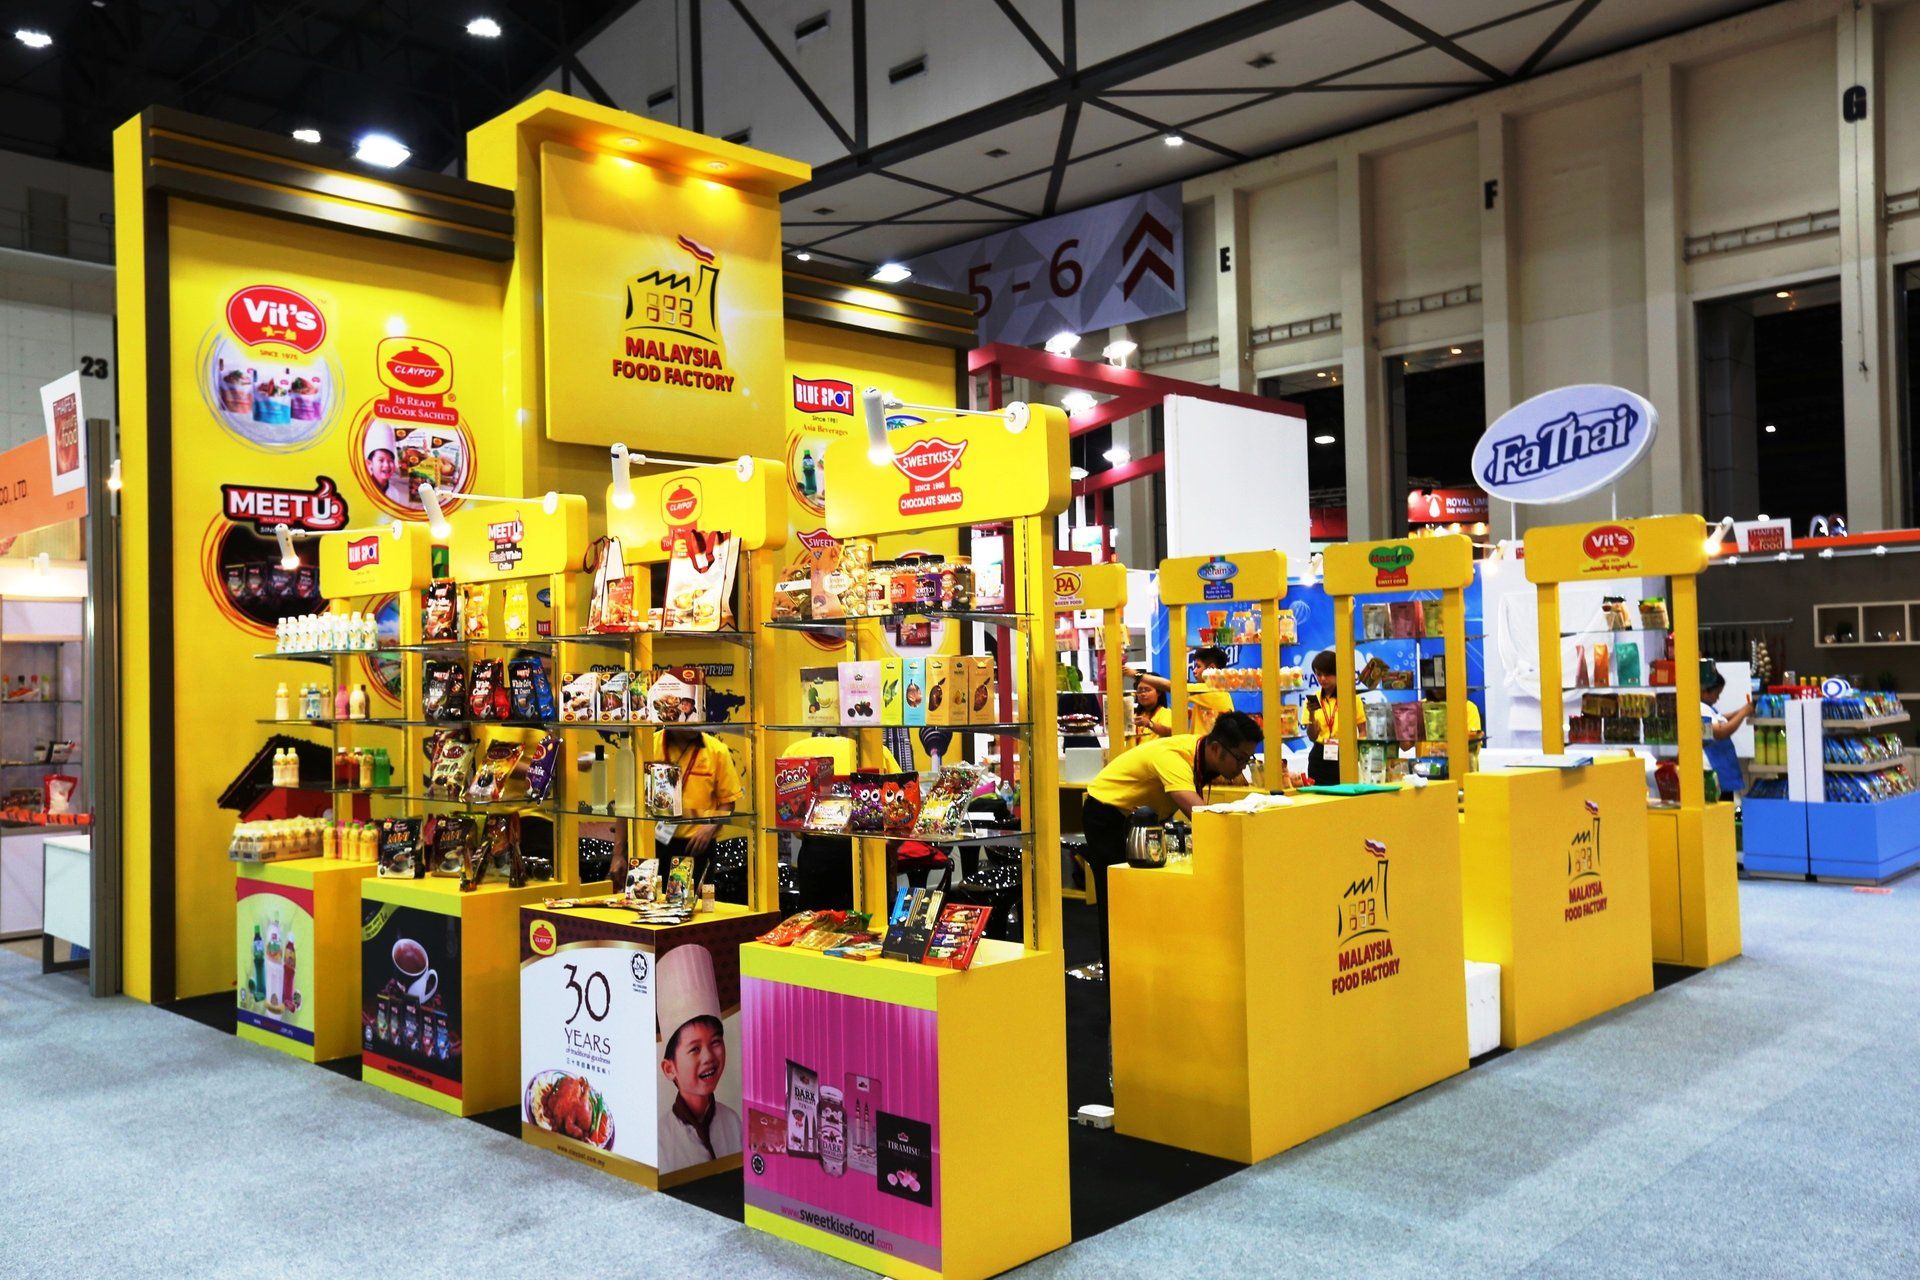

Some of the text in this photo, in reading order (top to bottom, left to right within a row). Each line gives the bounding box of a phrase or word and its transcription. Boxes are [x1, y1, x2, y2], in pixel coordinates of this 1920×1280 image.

[1843, 85, 1867, 123] G
[1484, 180, 1498, 209] F
[1220, 246, 1231, 273] E
[243, 297, 318, 331] Vit's
[625, 336, 723, 370] MALAYSIA
[80, 355, 109, 379] 23
[394, 365, 437, 378] CLAYPOT
[612, 359, 735, 393] FOOD FACTORY
[796, 382, 851, 409] BLUE SPOT
[803, 424, 849, 436] Asia Beverages
[903, 450, 954, 469] SWEETKISS
[230, 490, 308, 518] MEET
[901, 492, 962, 509] CHOCOLATE SNACKS
[1446, 498, 1471, 506] ROYAL
[488, 522, 513, 539] MEET
[1591, 533, 1629, 548] Vit's
[1056, 576, 1076, 591] PA
[1569, 881, 1603, 904] MALAYSIA
[1564, 897, 1608, 923] FOOD FACTORY
[1338, 938, 1393, 973] MALAYSIA
[1331, 957, 1401, 996] FOOD FACTORY
[564, 963, 611, 1026] 30
[564, 1027, 611, 1056] YEARS
[794, 1087, 816, 1102] DARK
[822, 1141, 842, 1153] DARK
[887, 1139, 921, 1157] TIRAMISU
